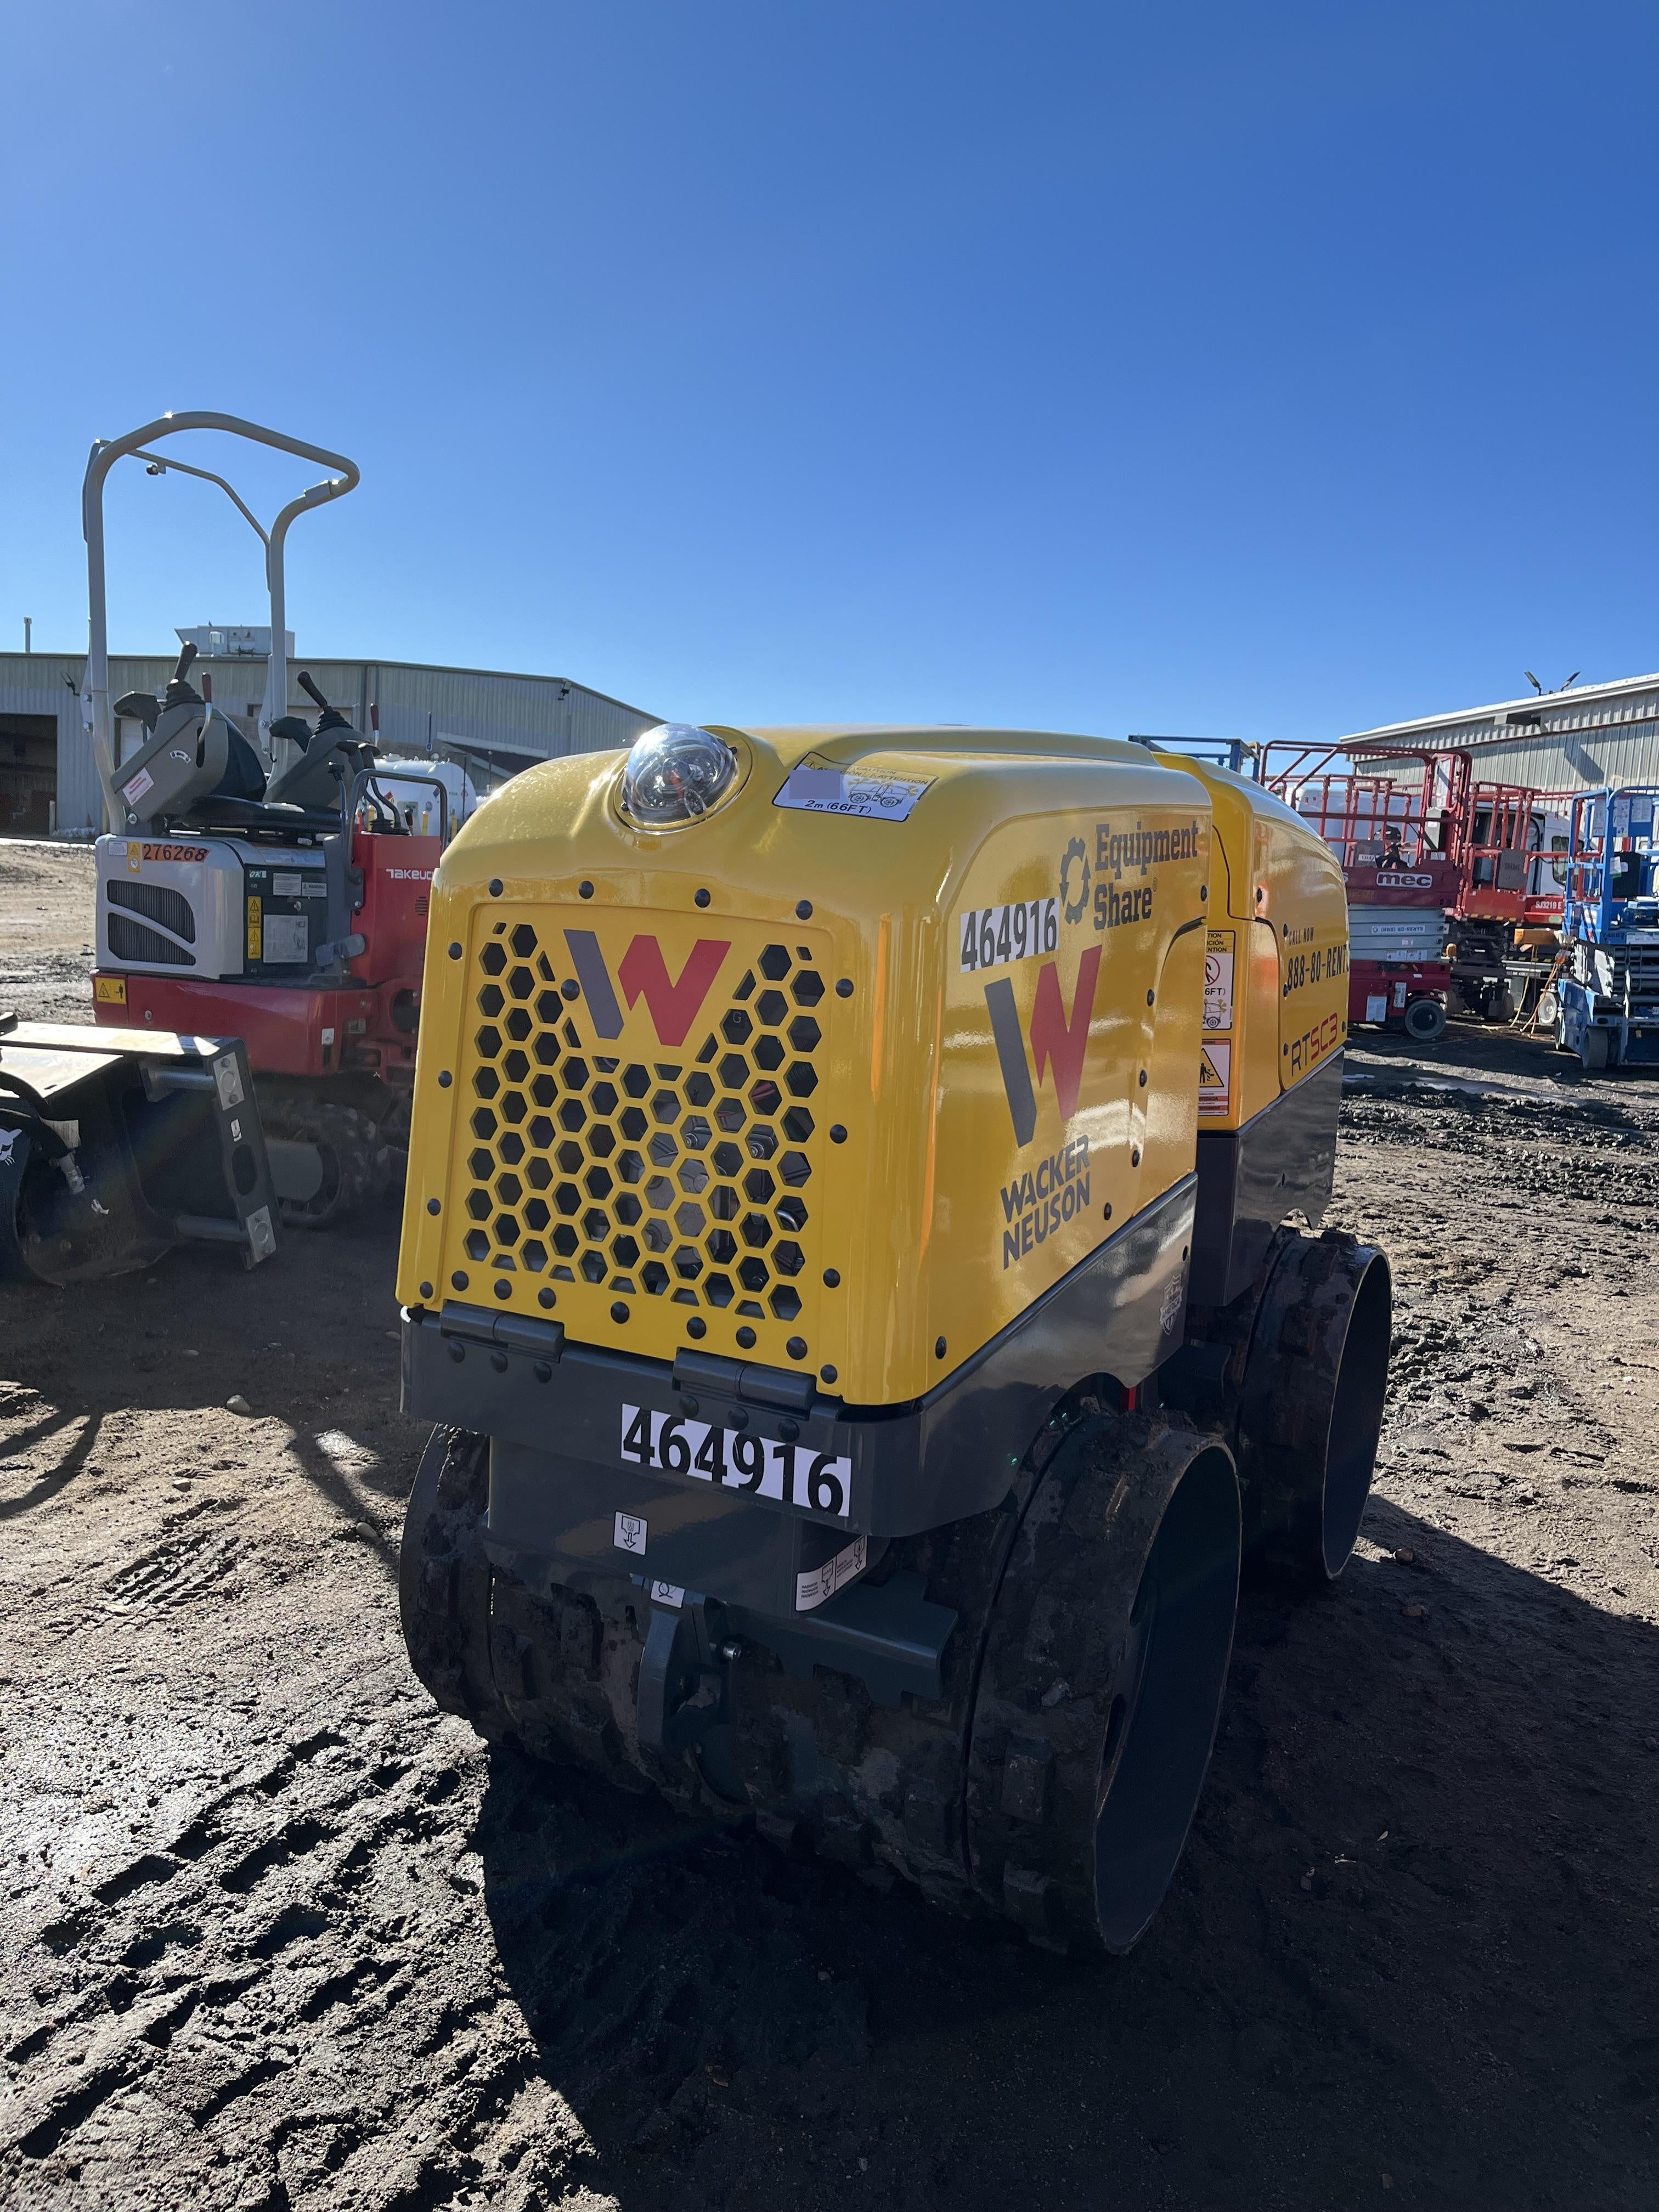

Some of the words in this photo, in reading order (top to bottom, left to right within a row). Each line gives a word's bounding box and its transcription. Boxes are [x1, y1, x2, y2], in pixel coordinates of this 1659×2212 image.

[877, 775, 928, 785] ATTENTION
[805, 800, 823, 809] 2m
[143, 844, 208, 861] 276268
[1094, 821, 1198, 879] Equipment
[1378, 873, 1431, 887] mec
[1093, 883, 1152, 930] Share
[961, 898, 1057, 971] 464916
[1289, 929, 1301, 946] CALL
[1304, 927, 1314, 943] NOW
[1000, 1134, 1091, 1223] WACKER
[1003, 1171, 1090, 1271] NEUSON
[623, 1408, 844, 1515] 464916
